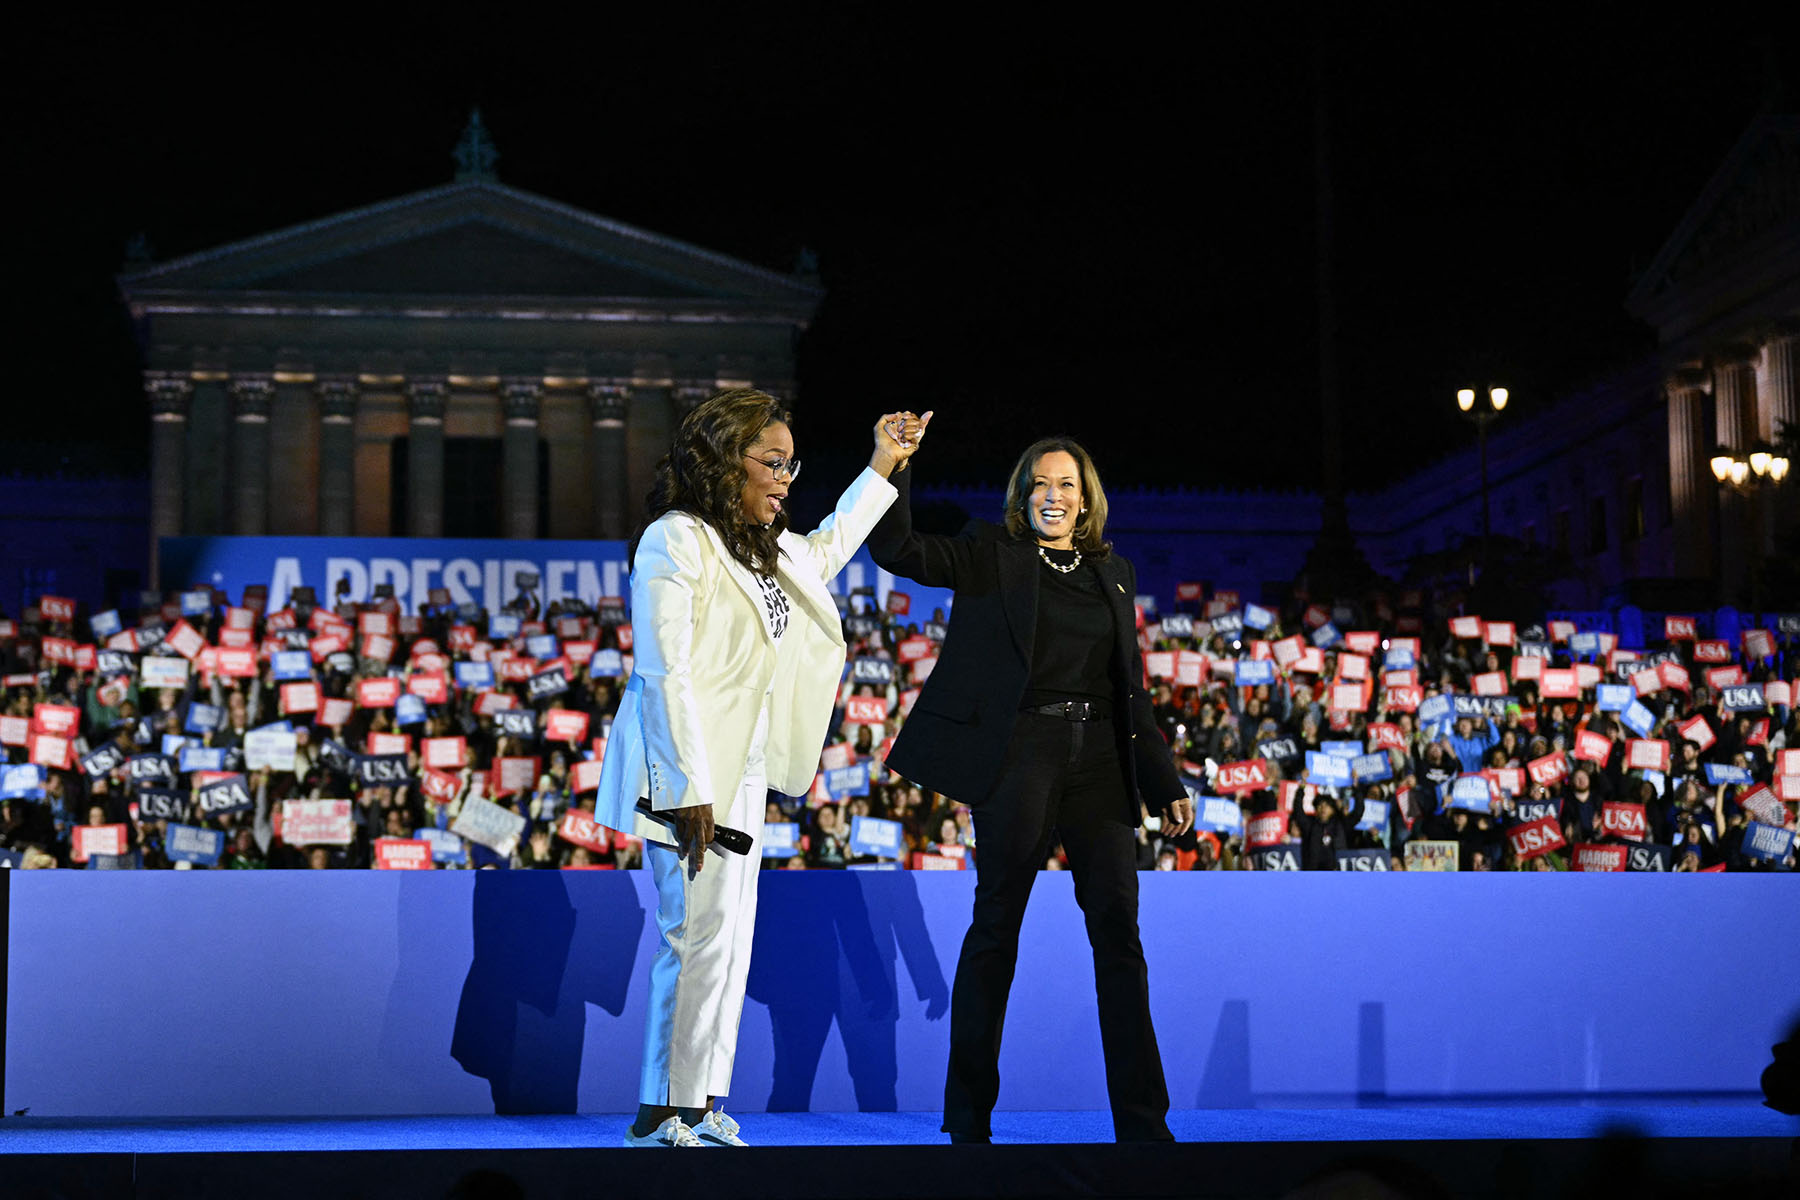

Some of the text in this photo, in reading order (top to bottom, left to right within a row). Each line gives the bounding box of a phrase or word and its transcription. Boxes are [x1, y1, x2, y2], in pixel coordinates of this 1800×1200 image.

[266, 558, 303, 616] A
[326, 558, 629, 617] PRESIDEN
[764, 588, 790, 619] SHE
[1162, 617, 1193, 633] USA
[1211, 614, 1242, 632] USA
[1667, 620, 1694, 636] USA
[1695, 643, 1726, 658] USA
[854, 660, 890, 679] USA
[530, 672, 568, 694] USA
[1387, 689, 1420, 707] USA
[1724, 687, 1762, 707] USA
[848, 702, 885, 720] USA
[1370, 727, 1406, 747] USA
[83, 746, 123, 776] USA
[131, 757, 172, 778] USA
[362, 759, 407, 782] USA
[1532, 758, 1566, 783] USA
[1219, 765, 1265, 787] USA
[140, 793, 182, 818] USA
[200, 783, 249, 812] USA
[1519, 803, 1557, 822] USA
[1604, 808, 1645, 831] USA
[564, 815, 607, 846] USA
[1511, 825, 1561, 854] USA
[1339, 857, 1388, 871] USA
[1578, 849, 1620, 867] HARRIS
